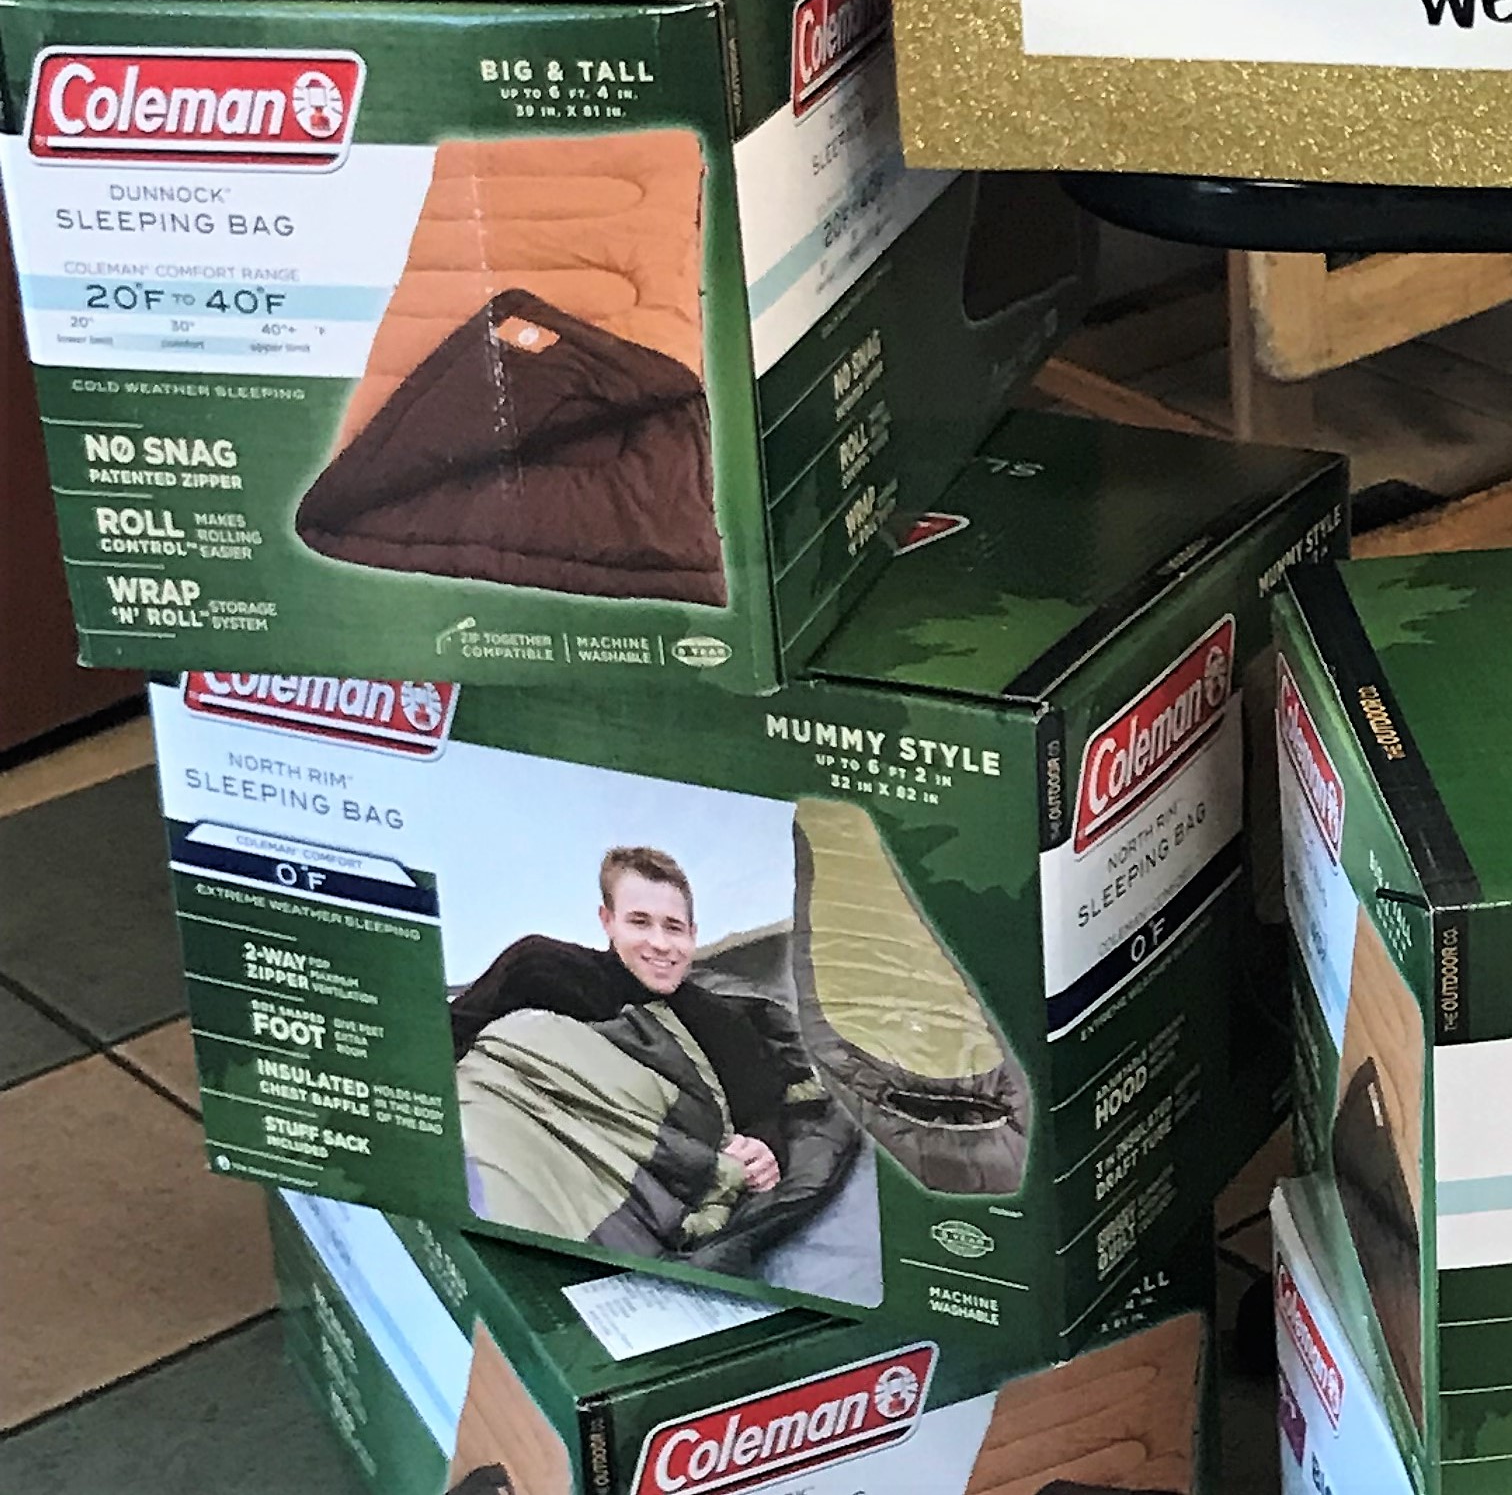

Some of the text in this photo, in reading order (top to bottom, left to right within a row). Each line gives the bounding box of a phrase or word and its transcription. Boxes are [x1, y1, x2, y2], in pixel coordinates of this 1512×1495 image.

[480, 59, 655, 83] BIG & TALL
[49, 62, 285, 136] Coleman
[56, 208, 296, 237] SLEEPING BAG
[143, 436, 239, 469] SNAG
[88, 468, 244, 491] PATENTED ZIPPER
[96, 505, 186, 539] ROLL
[106, 574, 202, 607] WRAP
[764, 712, 1002, 777] MUMMY STYLE
[1088, 678, 1201, 817] Coleman
[185, 767, 405, 831] SLEEPING BAG
[242, 941, 307, 973] 2-WAY
[245, 963, 310, 991] ZIPPER
[1442, 946, 1460, 1012] OUTDOOR
[251, 1012, 327, 1050] FOOT
[256, 1058, 370, 1099] INSULATED
[1095, 1065, 1148, 1131] HOOD
[263, 1115, 373, 1156] STUFF SACK
[654, 1391, 869, 1493] Coleman
